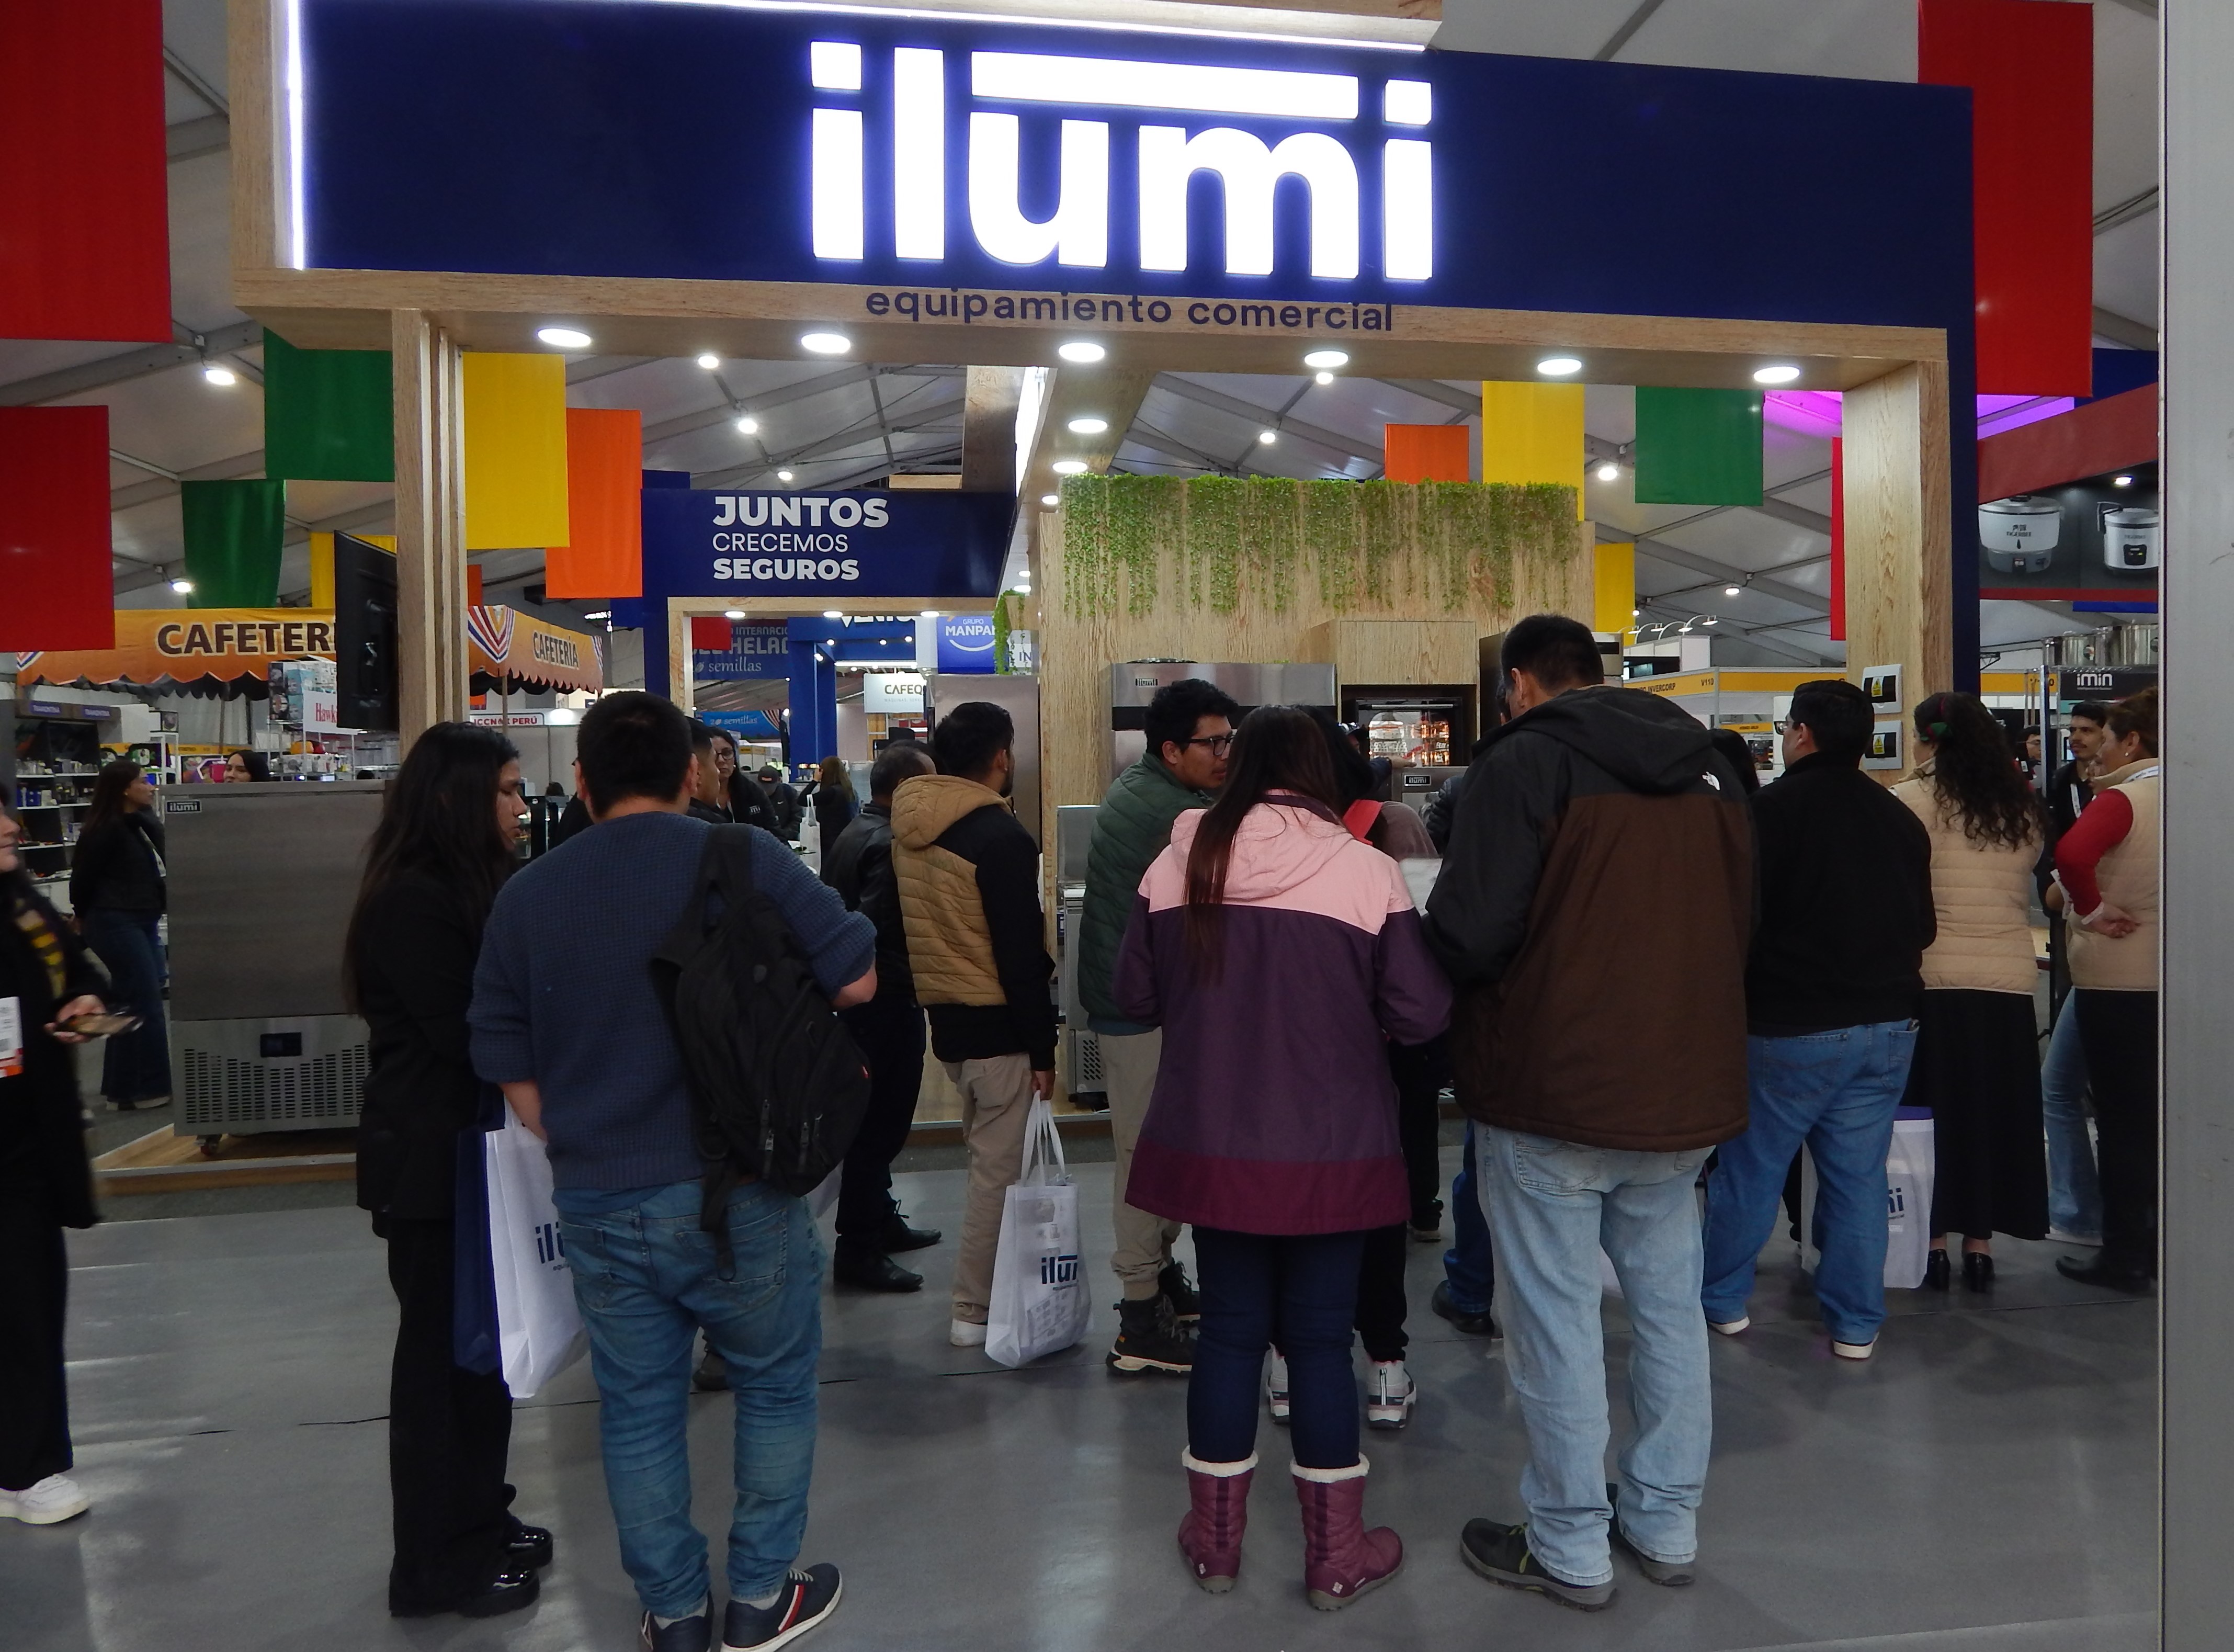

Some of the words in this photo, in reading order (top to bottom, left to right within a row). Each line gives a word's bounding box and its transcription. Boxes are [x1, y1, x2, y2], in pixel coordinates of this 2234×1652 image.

[810, 40, 1433, 281] ilumi
[866, 287, 1171, 324] equipamiento
[1187, 302, 1392, 332] comercial
[712, 496, 889, 528] JUNTOS
[712, 533, 849, 553] CRECEMOS
[713, 559, 859, 581] SEGUROS
[157, 623, 336, 654] CAFETER
[534, 632, 579, 668] CAFETERÍA
[708, 656, 762, 673] semillas
[884, 684, 923, 695] CAFEQ
[2077, 673, 2113, 686] imin
[513, 716, 538, 725] PERÚ
[724, 715, 758, 725] semillas
[169, 801, 198, 811] ilumi
